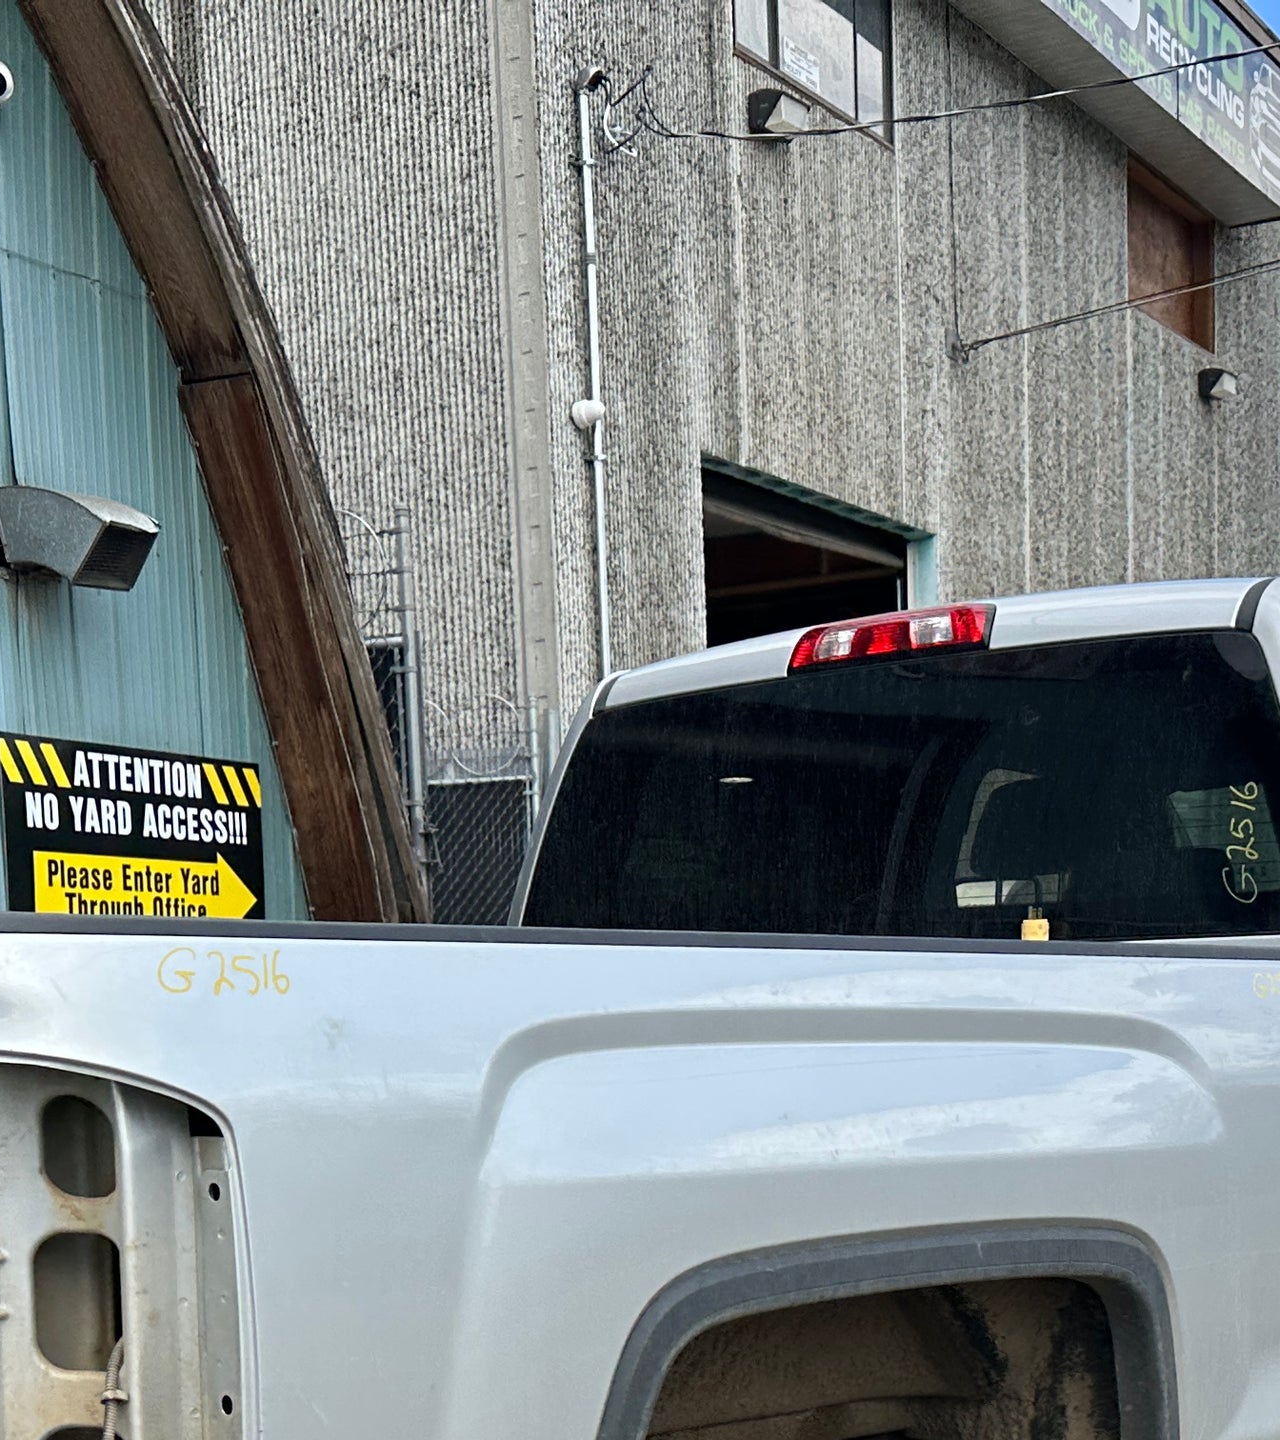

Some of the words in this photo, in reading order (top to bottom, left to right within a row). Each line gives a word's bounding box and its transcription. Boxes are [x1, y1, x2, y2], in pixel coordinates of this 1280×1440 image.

[1146, 12, 1245, 129] RECYCLING
[73, 750, 203, 800] ATTENTION
[24, 791, 60, 831] NO
[70, 796, 132, 836] YARD
[142, 803, 248, 846] ACCESS!!!
[1222, 781, 1259, 904] G2516
[47, 859, 113, 891] Please
[121, 864, 173, 894] Enter
[180, 867, 220, 896] Yard
[153, 896, 207, 918] Office
